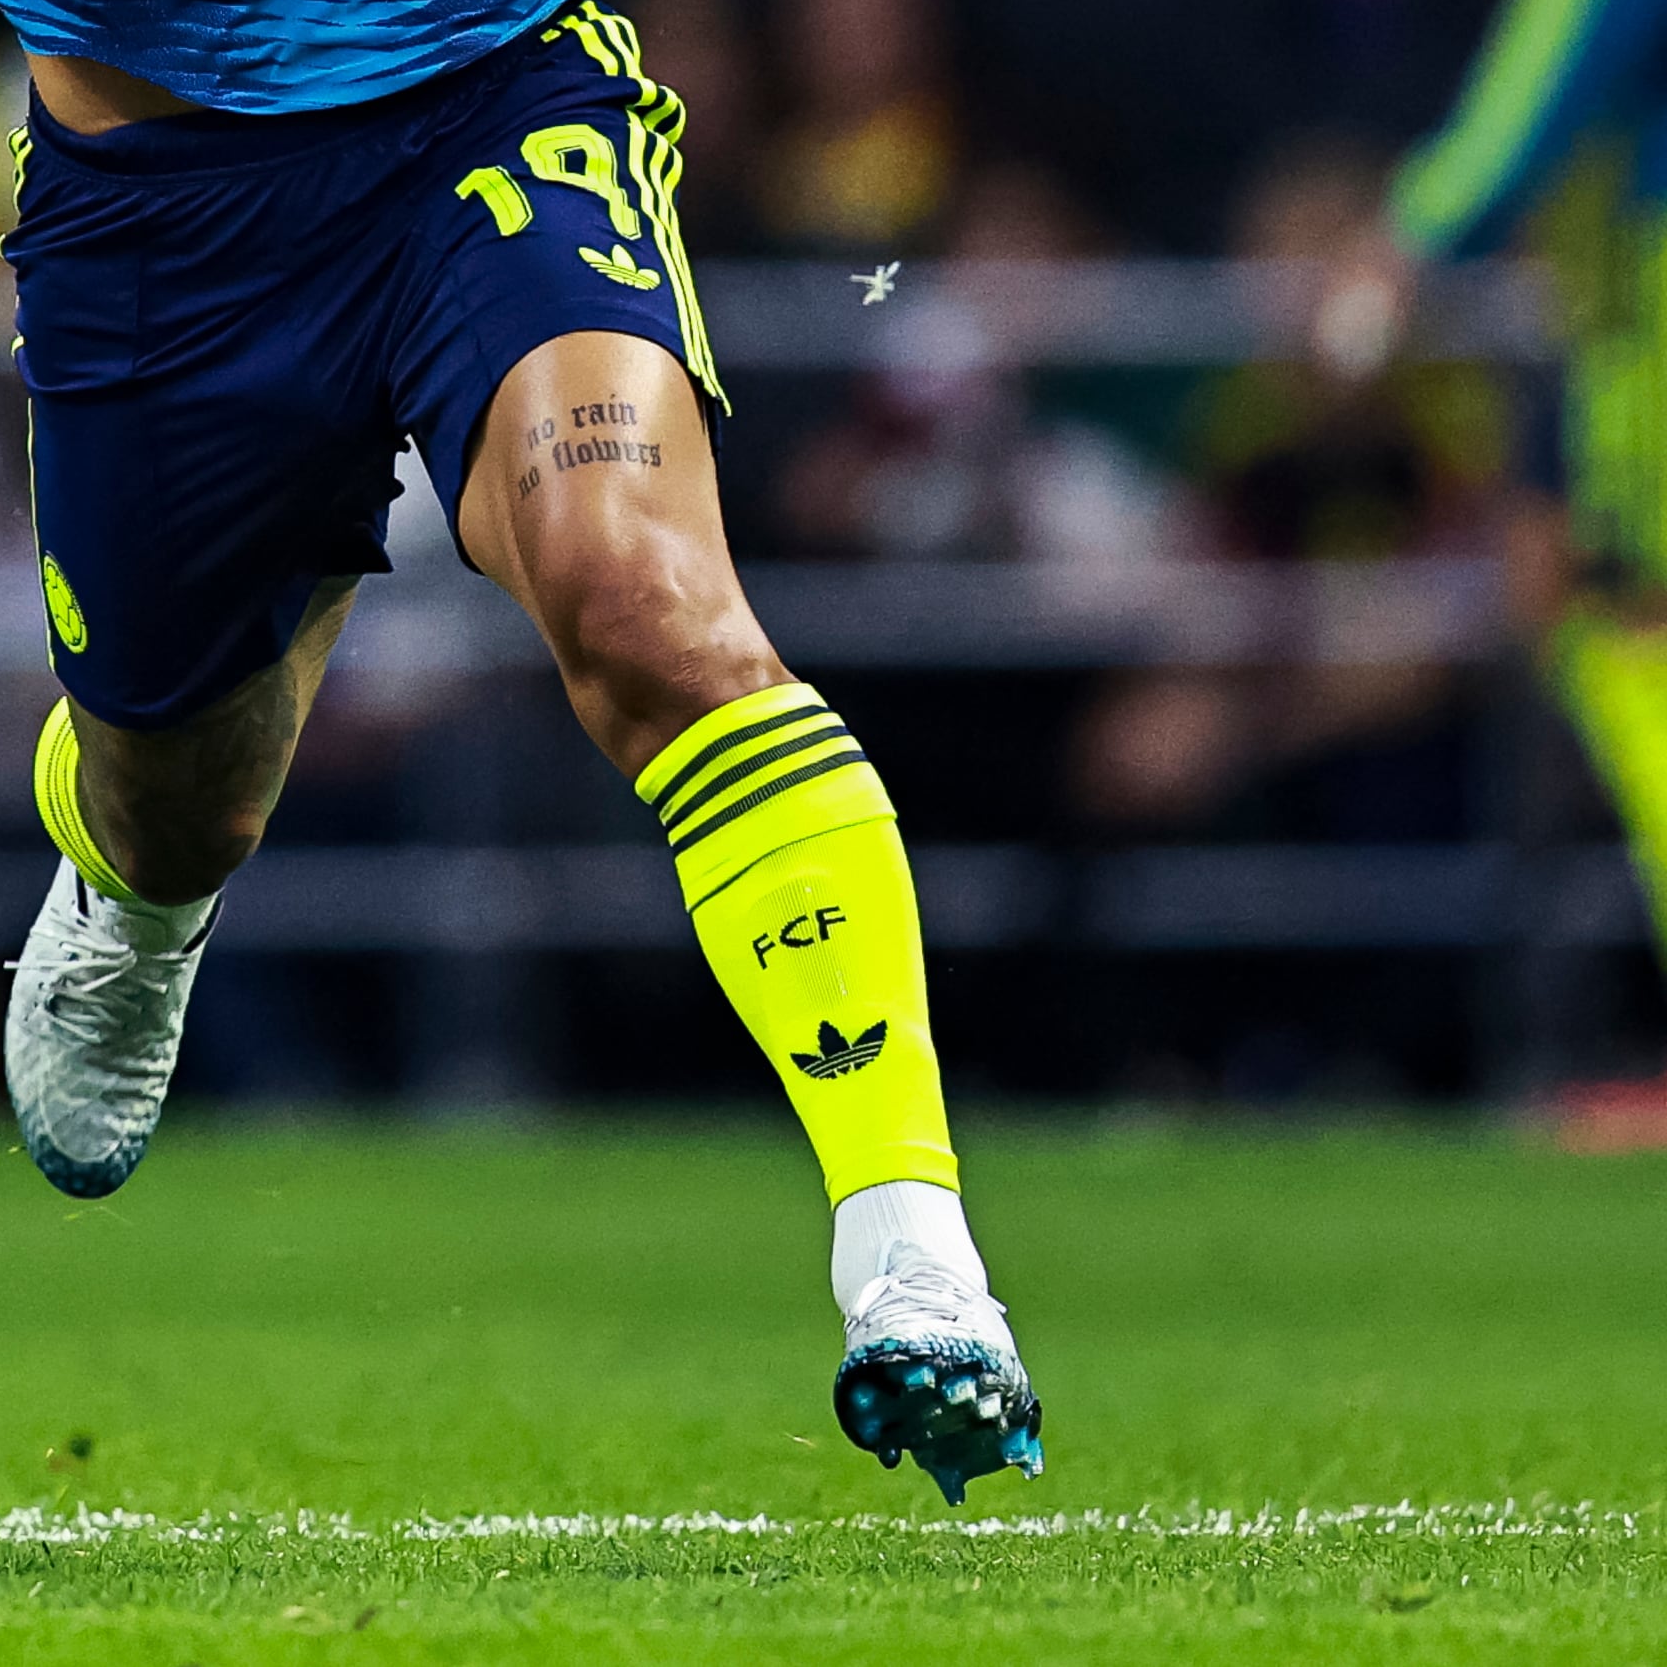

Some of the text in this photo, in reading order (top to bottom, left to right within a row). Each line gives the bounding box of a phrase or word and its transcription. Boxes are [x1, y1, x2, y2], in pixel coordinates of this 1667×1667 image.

[454, 123, 642, 241] 19
[527, 393, 638, 451] no rain
[517, 436, 662, 501] no flowers
[752, 905, 847, 971] FCF
